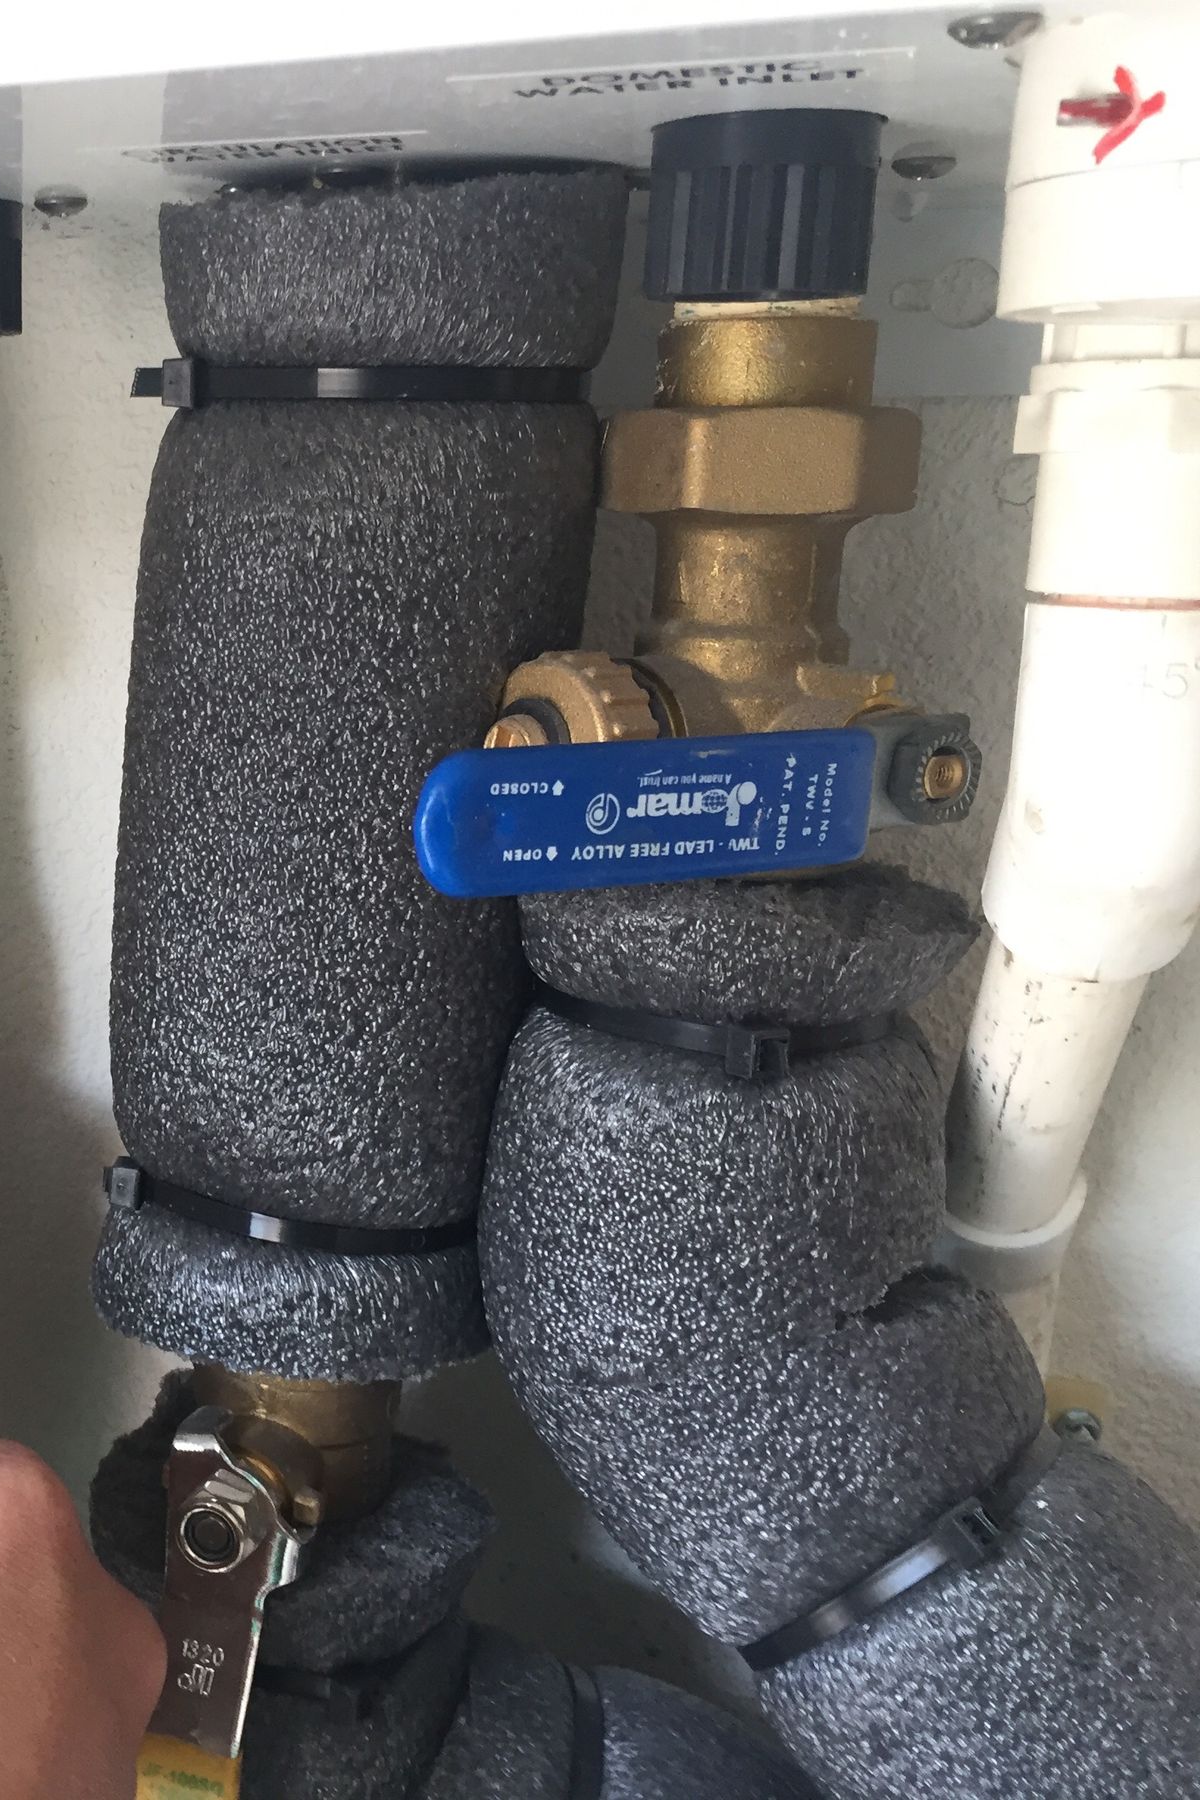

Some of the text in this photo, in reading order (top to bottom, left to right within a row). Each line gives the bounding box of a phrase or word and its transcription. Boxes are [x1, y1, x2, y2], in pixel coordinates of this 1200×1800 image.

[542, 61, 821, 87] DOMESTIC
[514, 68, 864, 98] WATER INLET
[662, 775, 679, 786] can
[681, 772, 697, 785] you
[698, 773, 724, 784] name
[724, 773, 733, 785] A
[490, 782, 548, 796] CLOSED
[805, 773, 819, 811] TWV
[626, 781, 758, 827] Jomar
[774, 752, 797, 856] PAT. PEND.
[817, 762, 838, 847] Model No.
[571, 844, 625, 861] ALLOY
[629, 842, 670, 858] FREE
[674, 839, 715, 855] LEAD
[728, 837, 761, 852] TWV
[503, 848, 541, 862] OPEN
